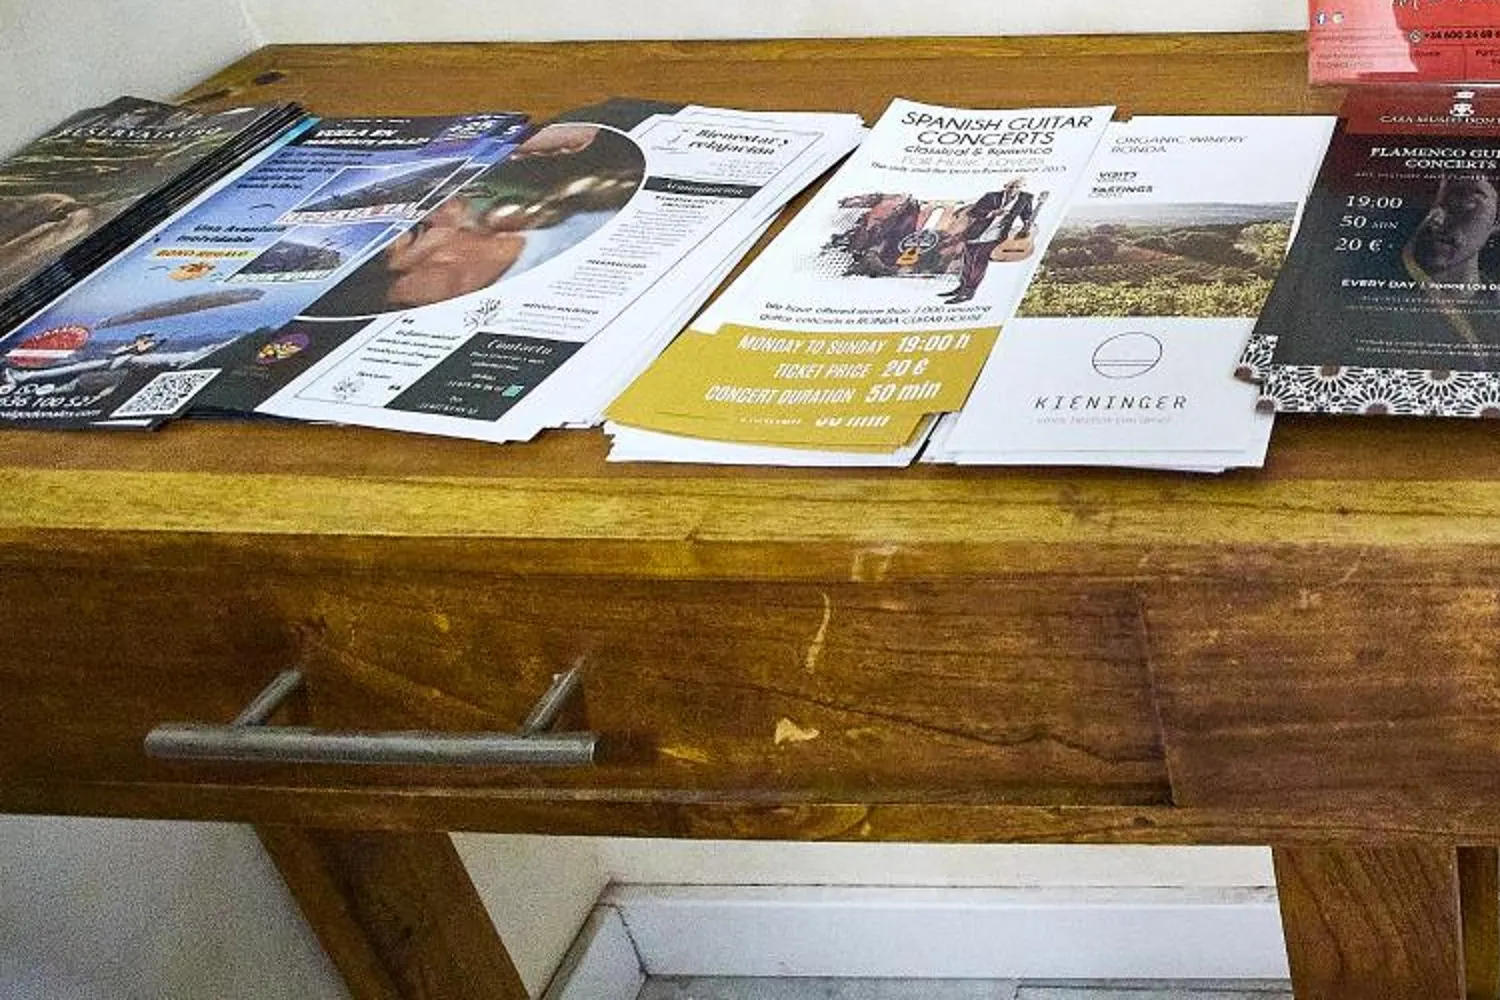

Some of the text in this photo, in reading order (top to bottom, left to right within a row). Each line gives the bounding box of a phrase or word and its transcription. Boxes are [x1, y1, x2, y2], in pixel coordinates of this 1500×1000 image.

[901, 111, 1093, 131] SPANISH GUITAR
[1379, 115, 1413, 124] CASA
[1465, 117, 1495, 125] DON
[917, 131, 1056, 146] CONCERTS
[1370, 147, 1467, 158] FLAMENCO
[1405, 159, 1498, 170] CONCERTS
[1345, 194, 1403, 209] 19:00
[1340, 215, 1367, 229] 50
[1334, 237, 1383, 252] 20 €
[1341, 279, 1386, 288] EVERY
[1389, 280, 1416, 290] DAY
[737, 334, 802, 353] MONDAY
[804, 338, 826, 353] TO
[826, 339, 888, 355] SUNDAY
[895, 335, 953, 352] 19:00
[773, 362, 822, 379] TICKET
[824, 362, 872, 379] PRICE
[881, 359, 911, 378] 20
[704, 381, 942, 405] CONCERT DURATION 50 min
[1035, 395, 1188, 410] KIENINGER
